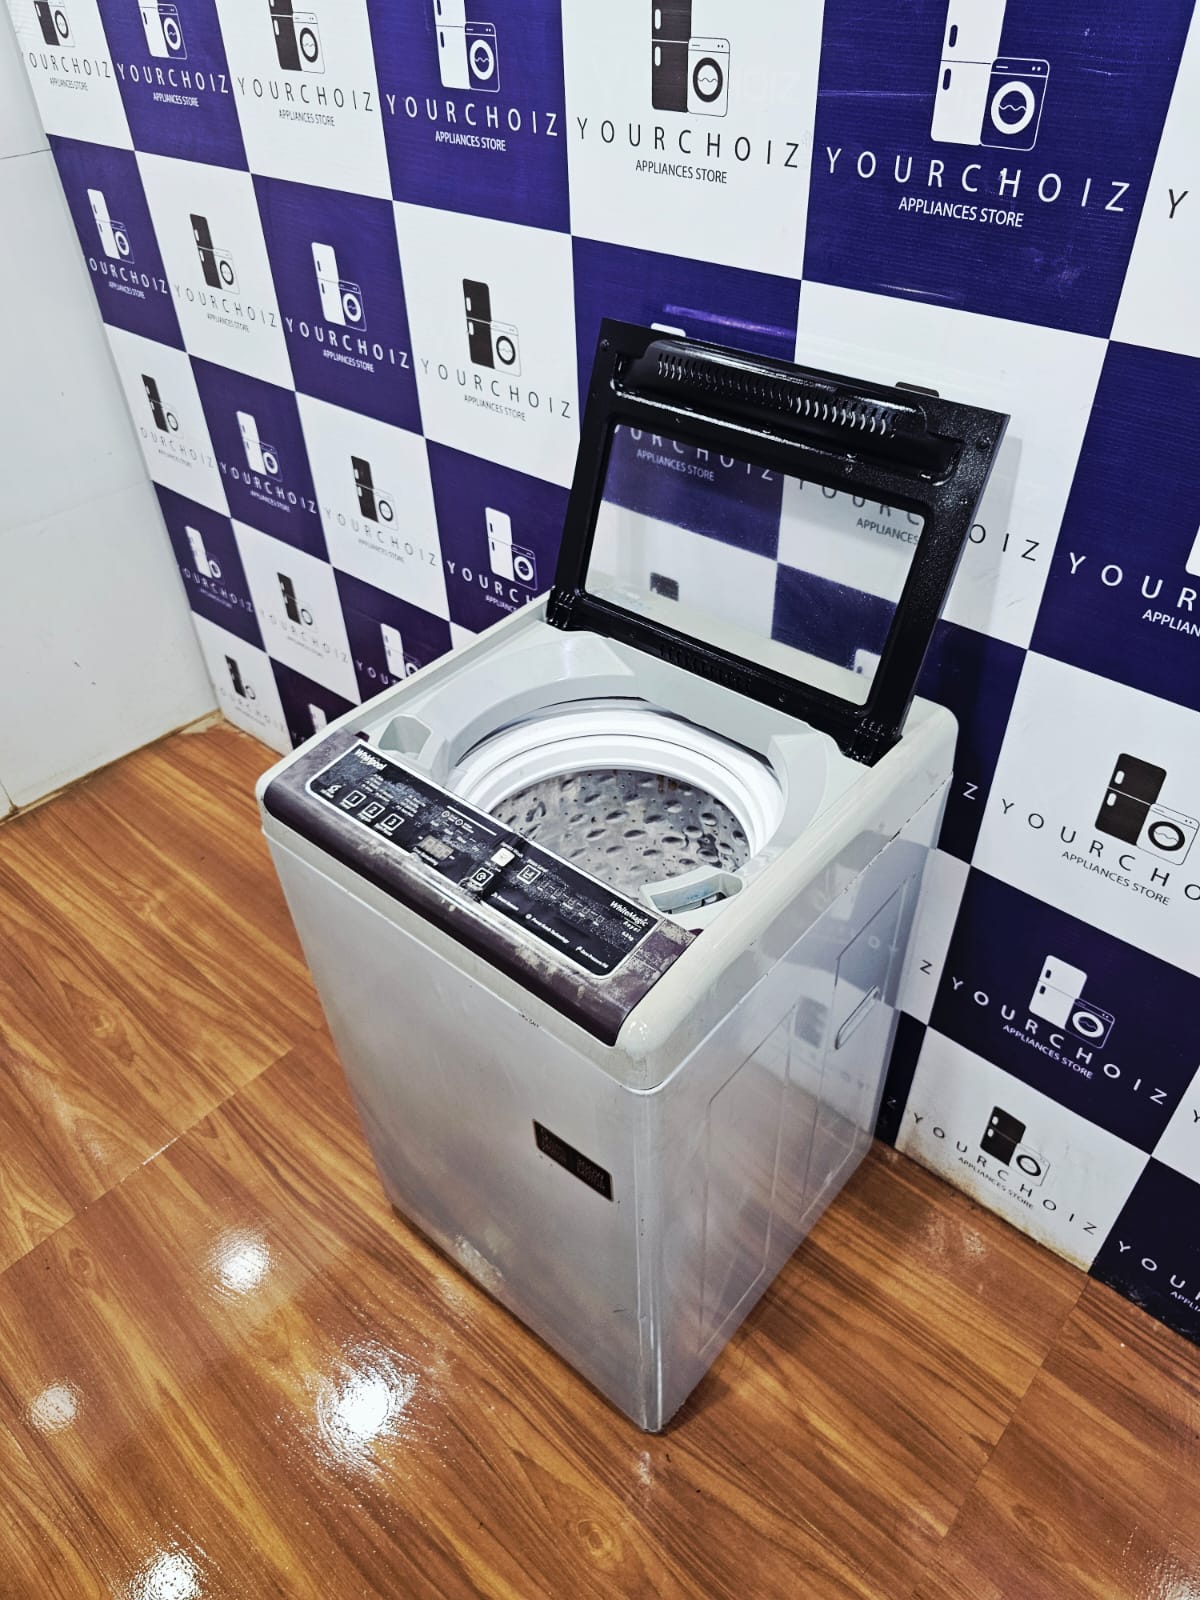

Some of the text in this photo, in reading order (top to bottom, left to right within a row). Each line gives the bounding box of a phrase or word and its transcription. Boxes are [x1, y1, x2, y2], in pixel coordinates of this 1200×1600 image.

[29, 52, 111, 79] OURCHOIZ
[117, 63, 229, 94] YOURCHOIZ
[237, 77, 374, 112] YOURCHOIZ
[386, 93, 559, 137] YOURCHOIZ
[279, 109, 335, 127] APPLIANCES STORE
[435, 130, 506, 151] APPLIANCES STORE
[576, 116, 799, 168] YOURCHOIZ
[635, 159, 728, 184] APPLIANCES STORE
[826, 146, 1130, 212] YOURCHOIZ
[898, 196, 1025, 228] APPLIANCES STORE
[88, 257, 168, 294] OURCHOIZ
[173, 284, 277, 328] YOURCHOIZ
[285, 317, 410, 369] YOURCHOIZ
[323, 349, 375, 373] APPLIANCES STORE
[420, 358, 571, 419] YOURCHOIZ
[464, 394, 526, 422] APPLIANCES STORE
[140, 426, 215, 470] OURCHOIZ
[637, 449, 715, 482] APPLIANCES STORE
[219, 461, 317, 514] YOURCHOIZ
[324, 506, 437, 567] YOURCHOIZ
[183, 567, 254, 613] OURCHOIZ
[353, 748, 387, 770] Whirlpool
[1062, 850, 1170, 906] APPLIANCES STORE
[610, 900, 648, 928] WhiteMagic
[951, 976, 1168, 1105] YOURCHOIZ
[1003, 1024, 1094, 1080] APPLIANCES STORE
[913, 1112, 1097, 1235] YOURCHOIZ
